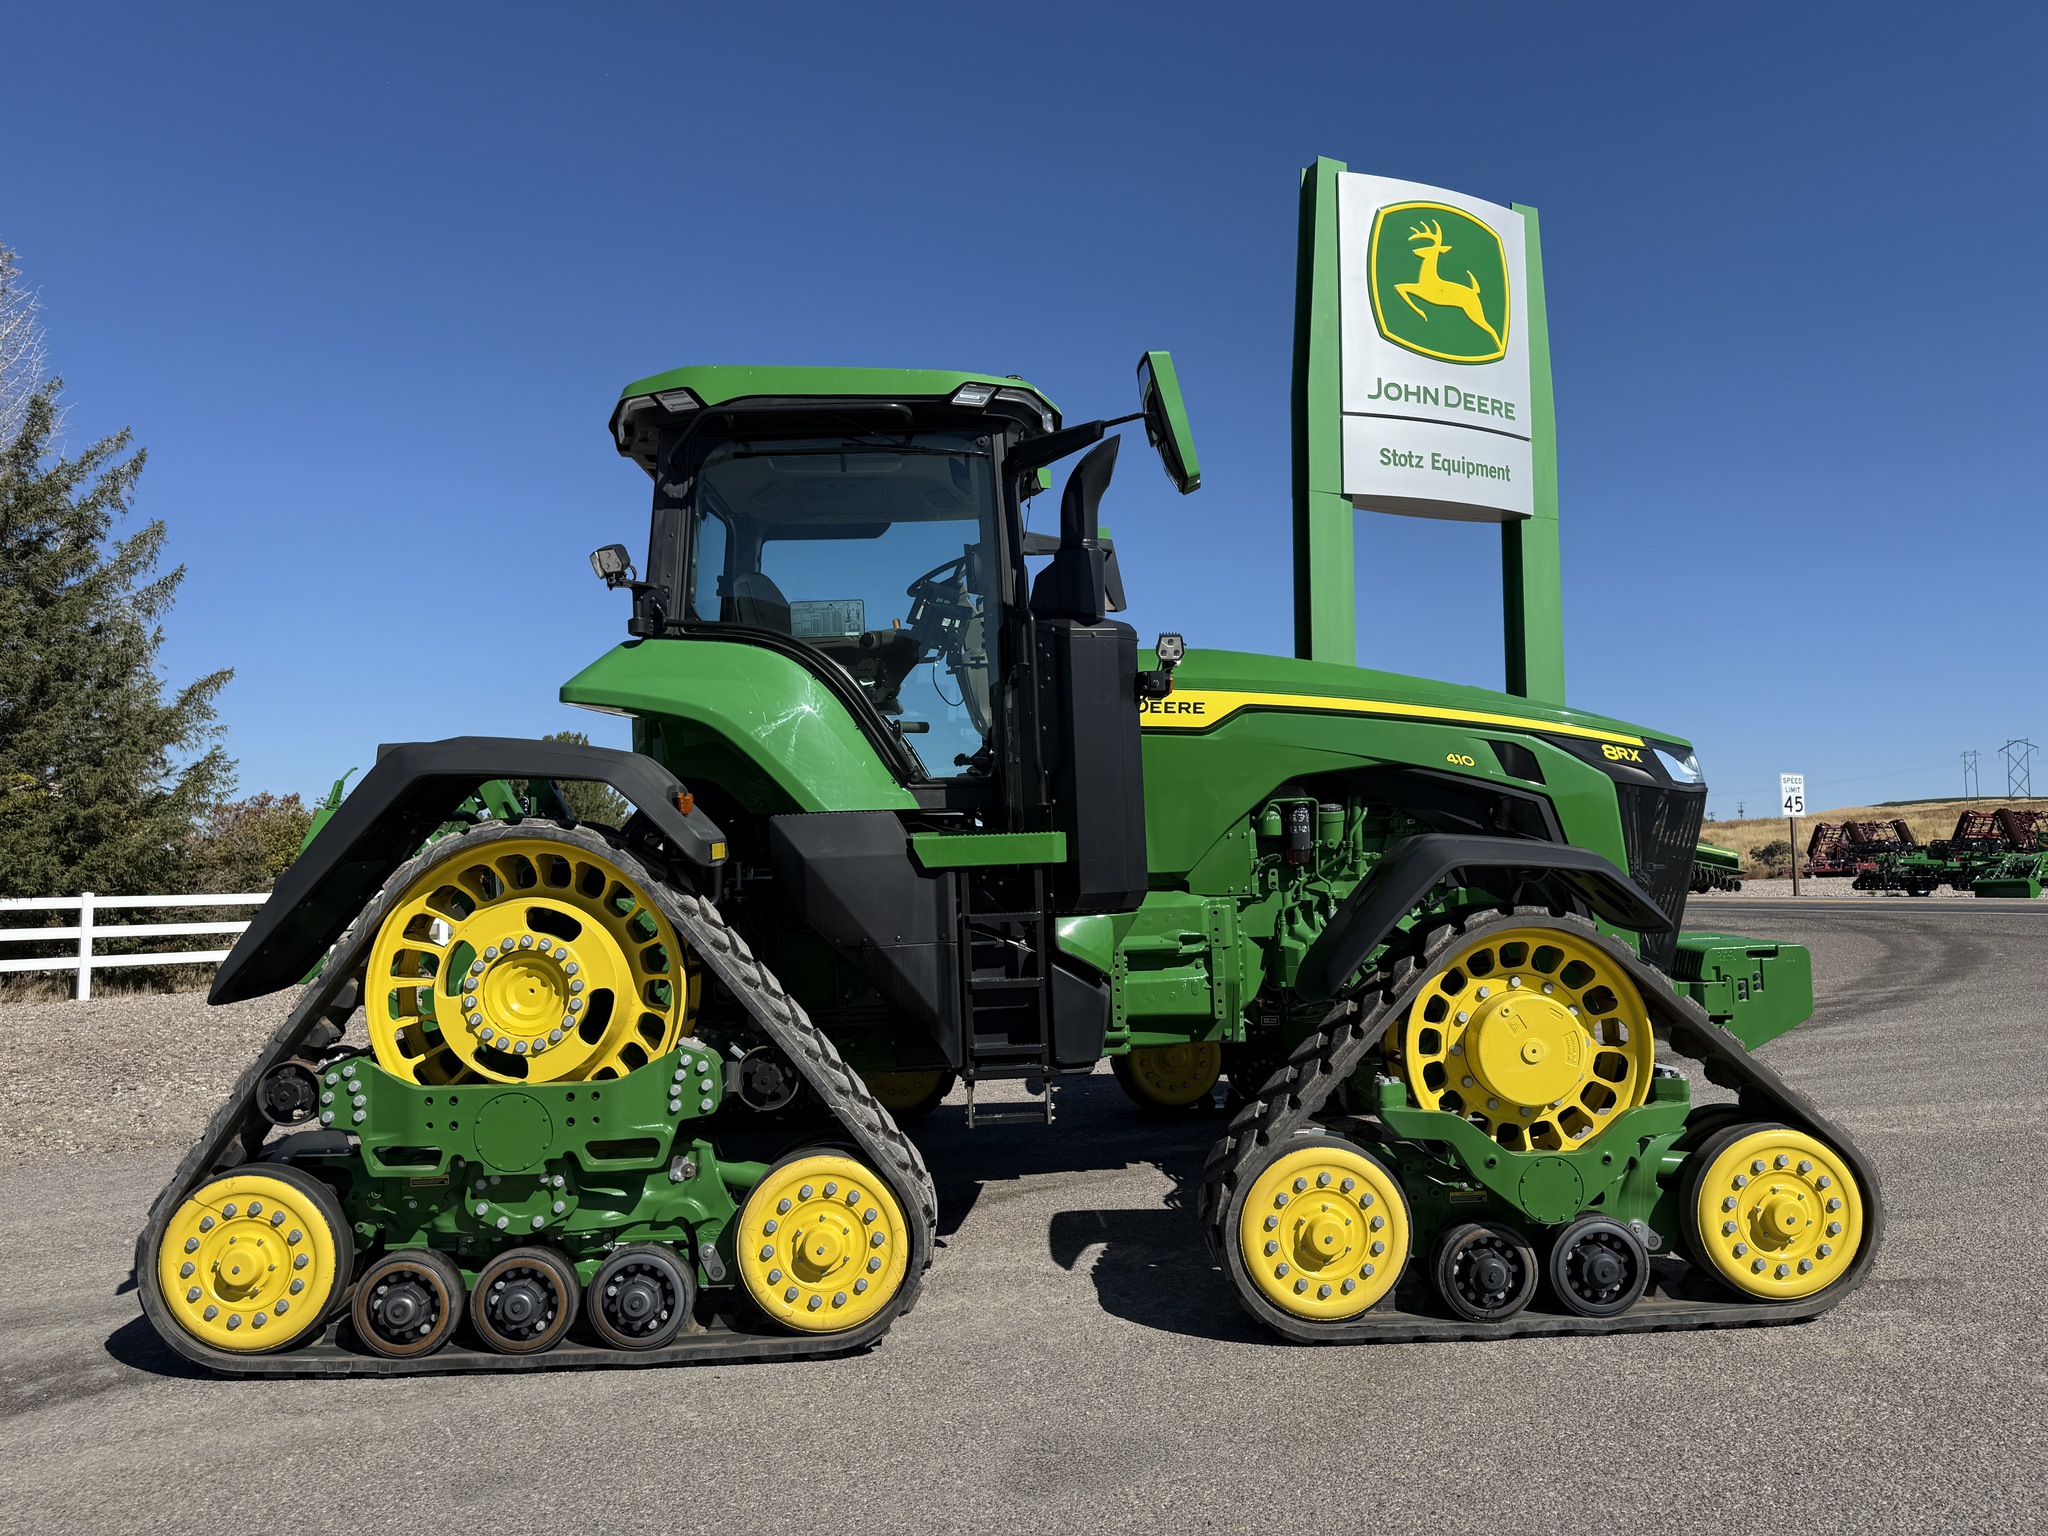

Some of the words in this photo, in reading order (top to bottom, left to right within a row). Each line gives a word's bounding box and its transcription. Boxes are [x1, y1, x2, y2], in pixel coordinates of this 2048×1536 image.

[1367, 377, 1439, 406] JOHN
[1444, 385, 1516, 421] DEERE
[1379, 447, 1424, 469] Stotz
[1431, 452, 1511, 482] Equipment
[1446, 753, 1476, 767] 410
[1601, 744, 1643, 763] 8RX
[1784, 796, 1803, 812] 45
